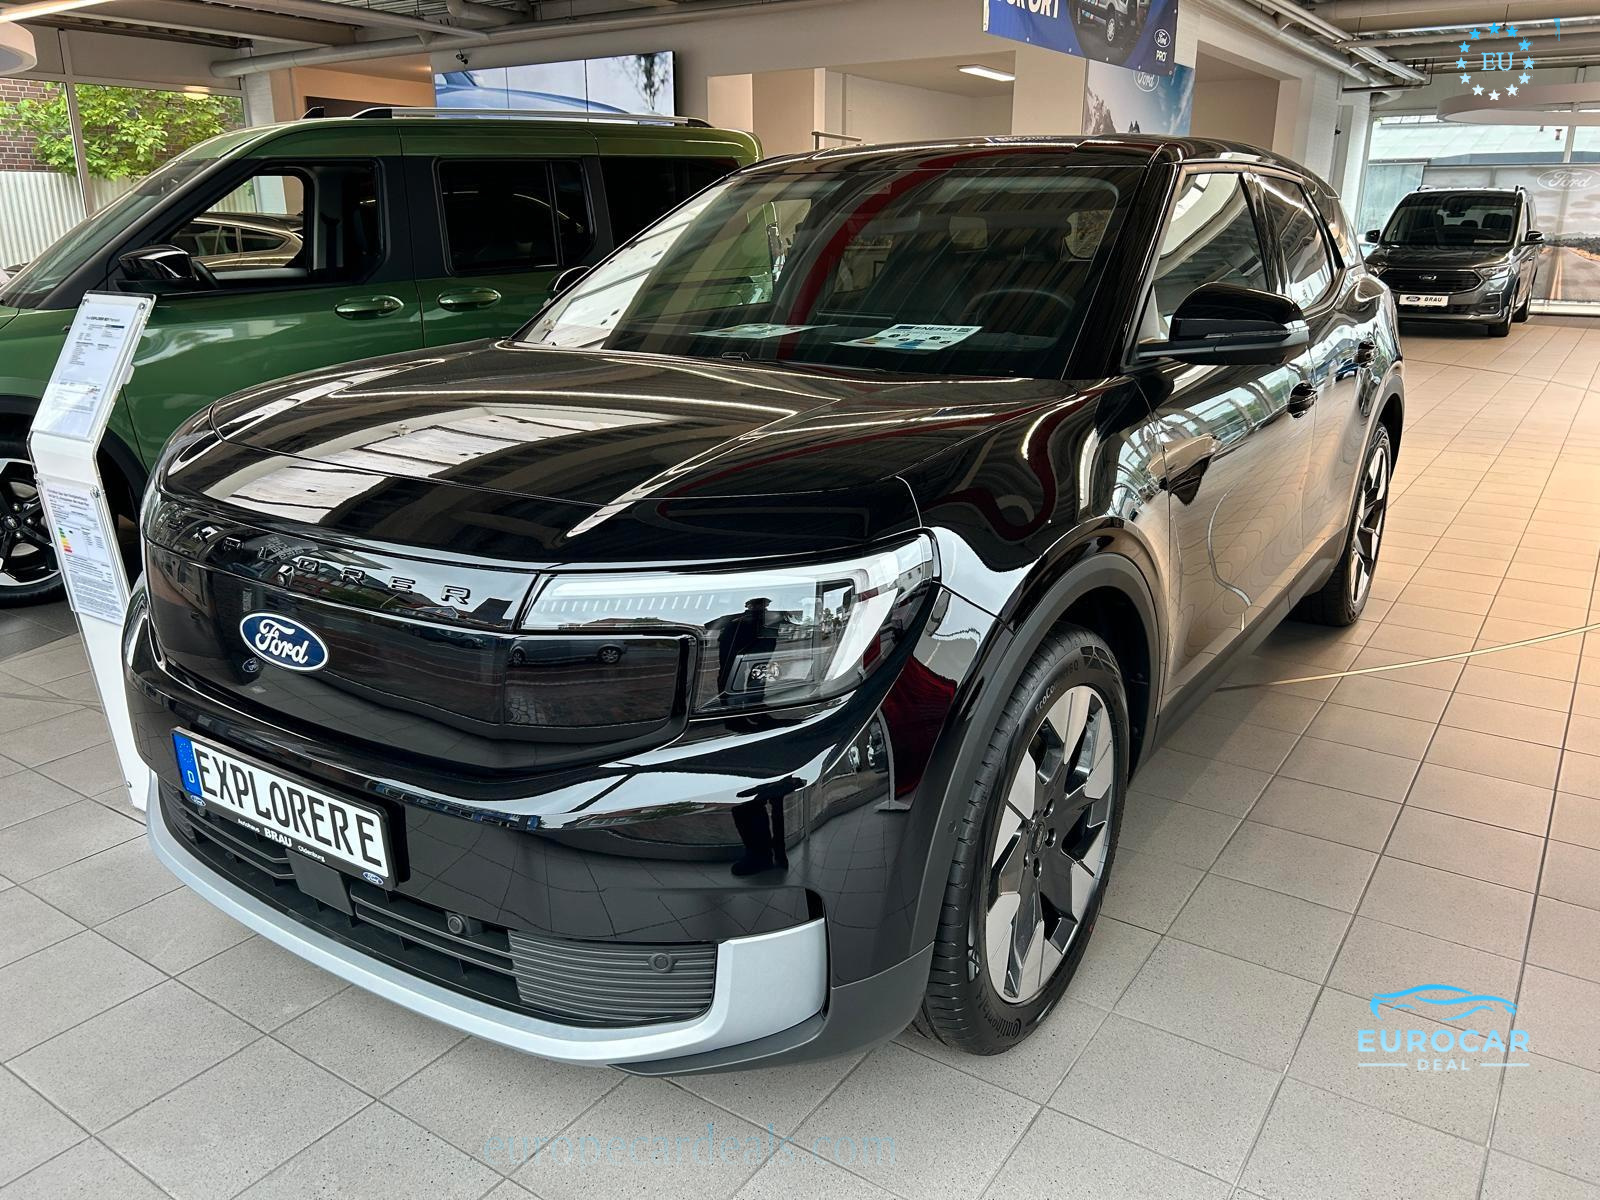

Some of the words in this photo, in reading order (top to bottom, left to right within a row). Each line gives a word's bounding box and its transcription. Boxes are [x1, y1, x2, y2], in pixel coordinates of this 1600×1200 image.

[1550, 172, 1592, 189] Ford
[255, 618, 309, 665] Ford
[187, 770, 195, 783] D
[264, 827, 292, 847] BRAU
